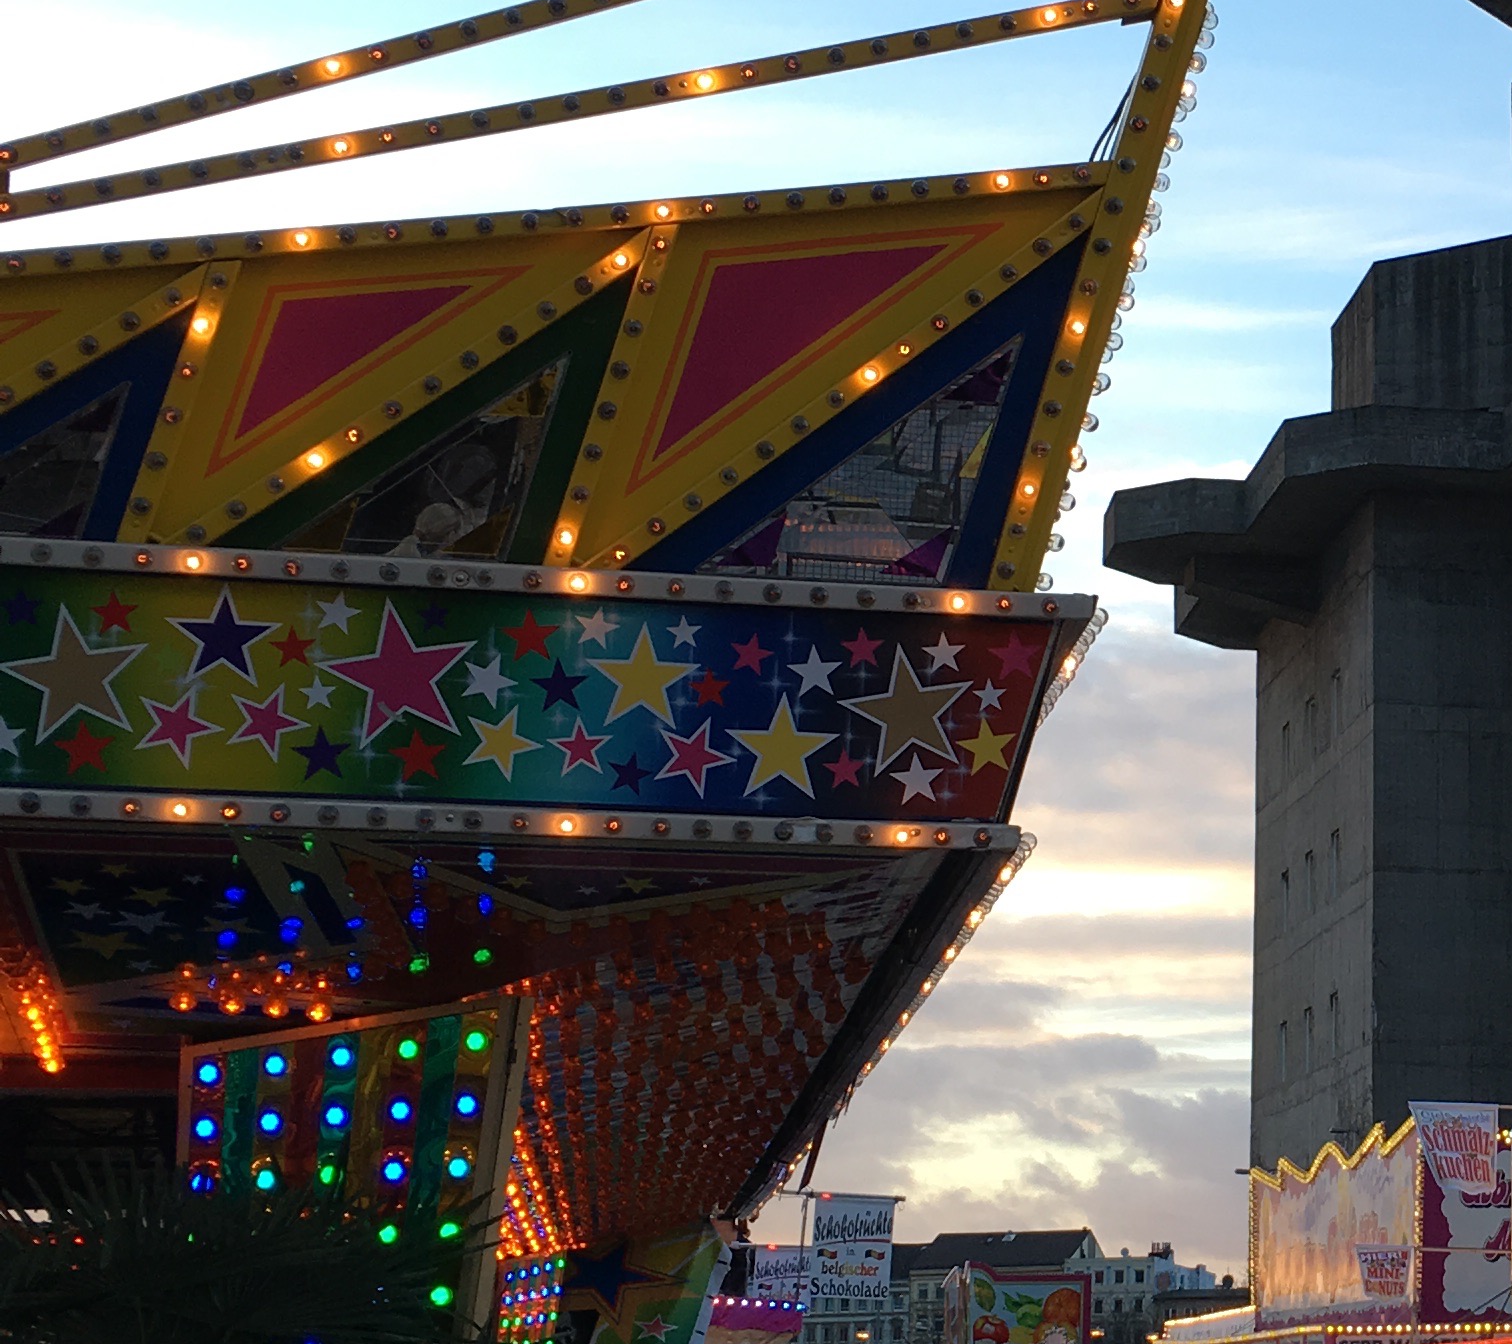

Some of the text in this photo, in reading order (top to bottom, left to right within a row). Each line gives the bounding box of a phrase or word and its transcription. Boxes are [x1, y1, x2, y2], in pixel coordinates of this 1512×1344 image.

[1421, 1123, 1495, 1156] Schmalz-
[1431, 1152, 1492, 1183] kuchen
[821, 1260, 880, 1278] belgischer
[811, 1277, 889, 1298] Schokolade
